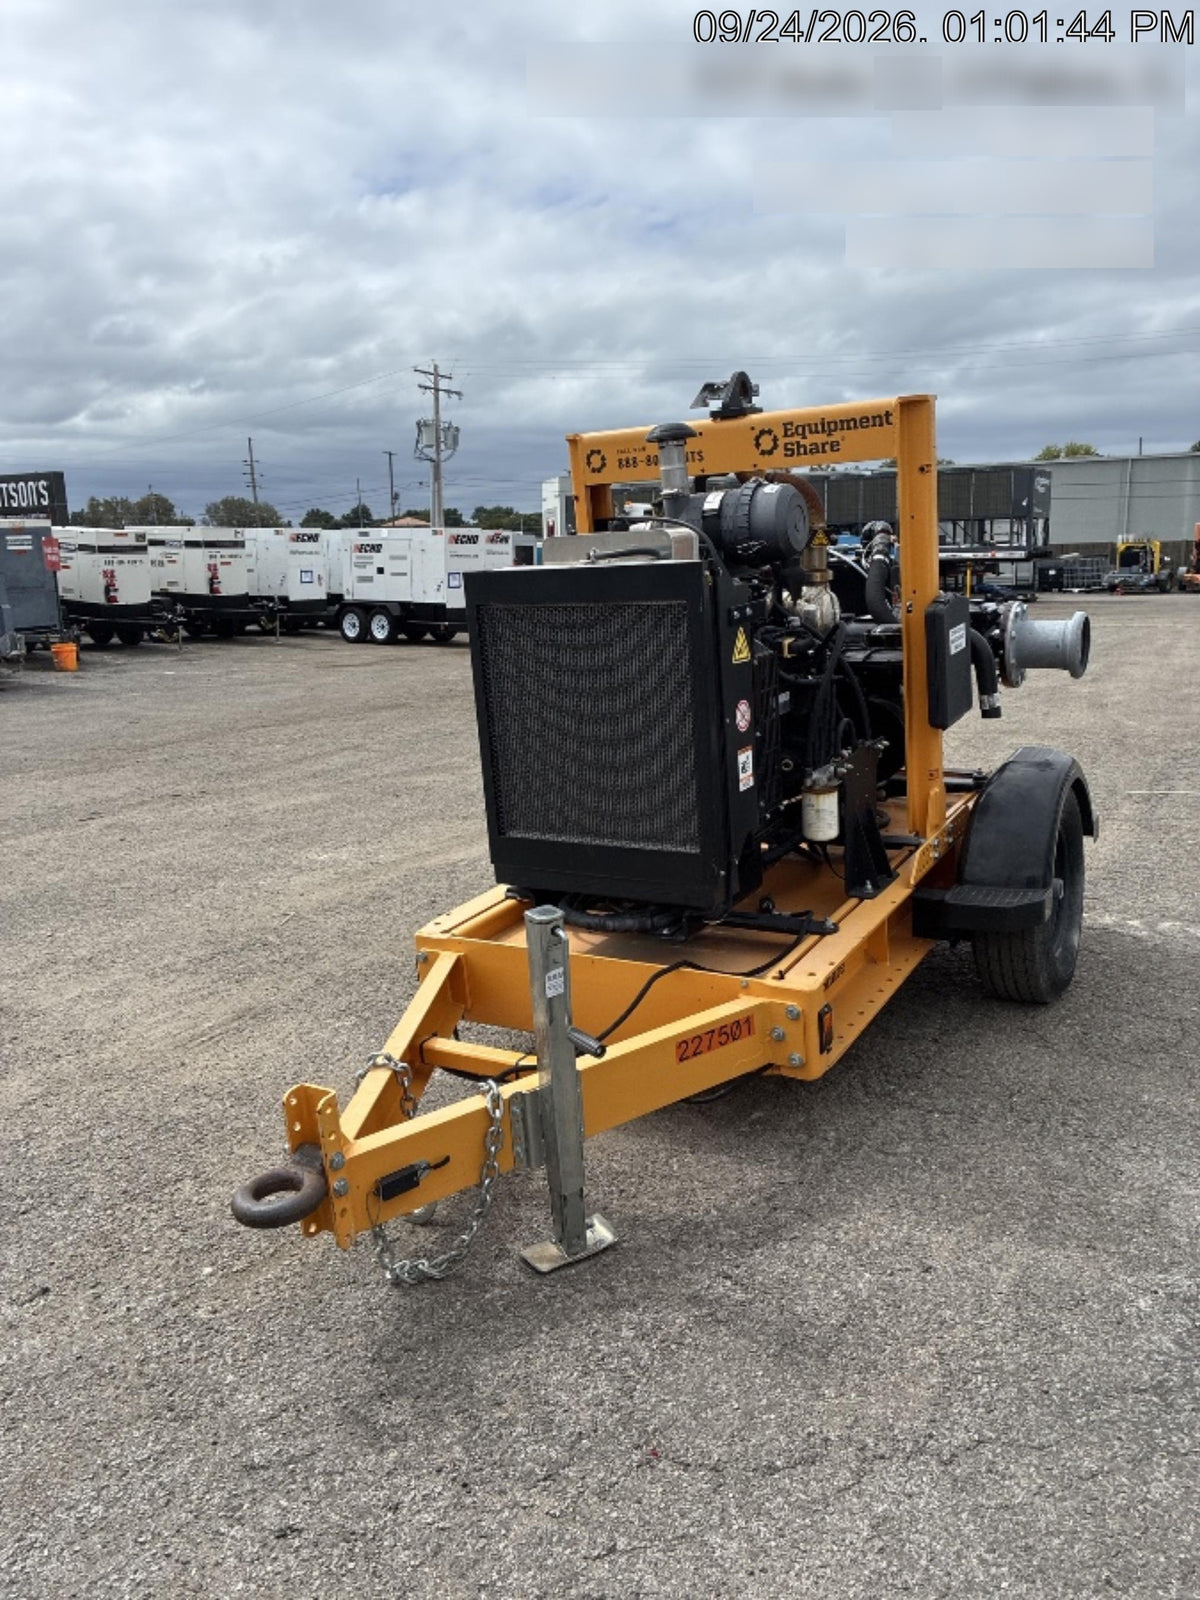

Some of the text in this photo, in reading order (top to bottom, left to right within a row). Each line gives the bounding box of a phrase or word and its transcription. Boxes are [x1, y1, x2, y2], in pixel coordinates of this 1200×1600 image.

[782, 410, 893, 439] Equipment
[783, 440, 841, 457] Share
[0, 480, 49, 507] TSON'S
[677, 1015, 752, 1063] 227501
